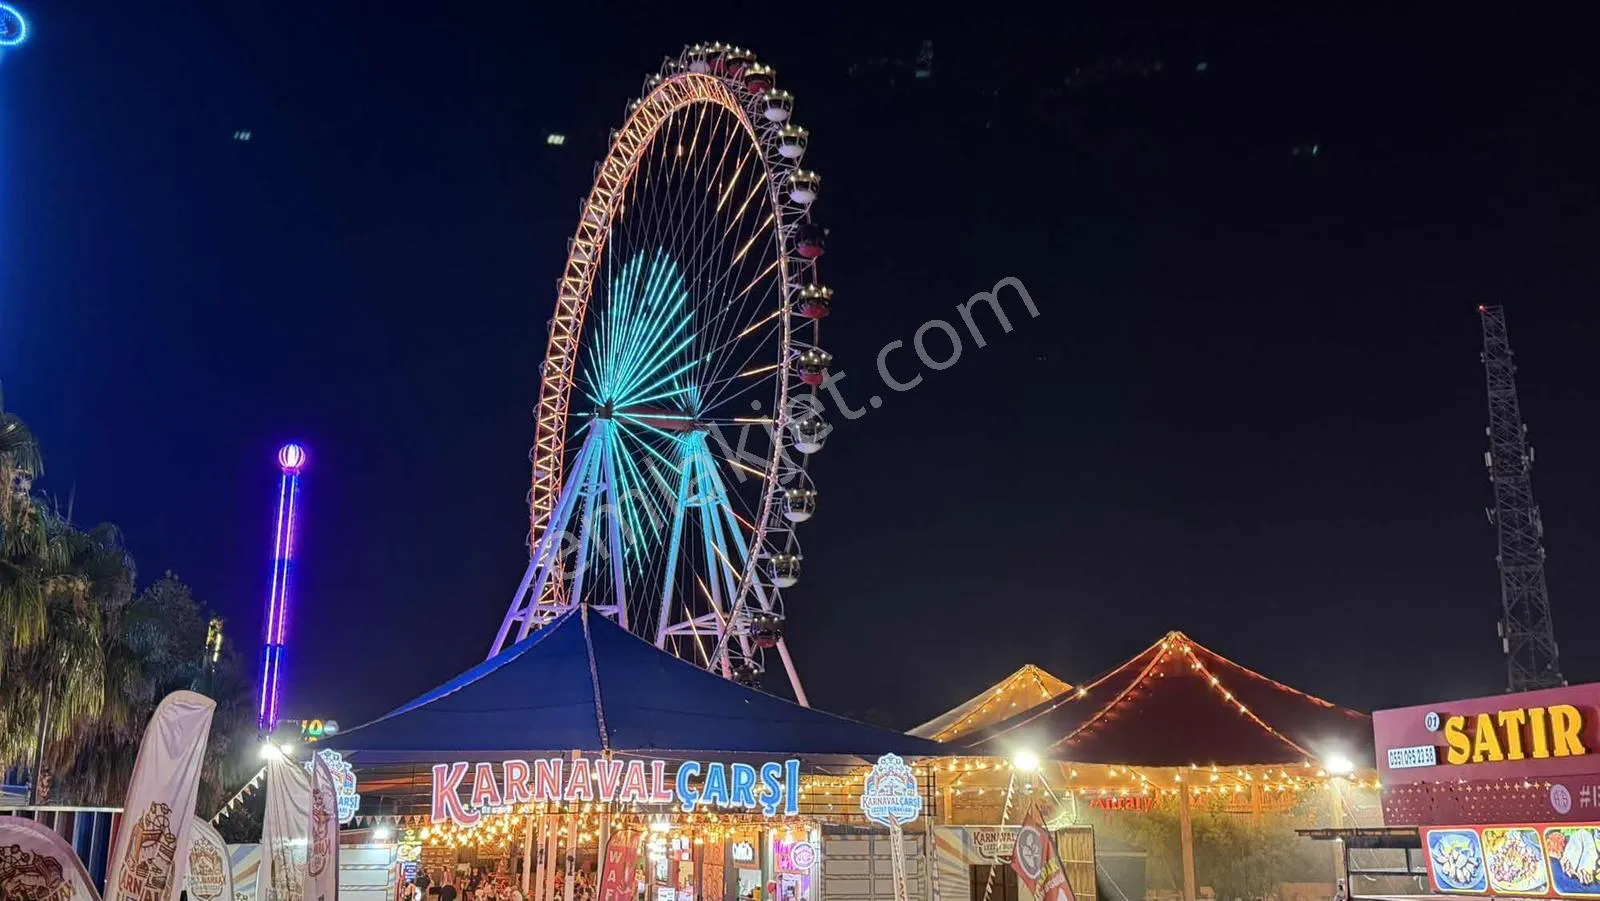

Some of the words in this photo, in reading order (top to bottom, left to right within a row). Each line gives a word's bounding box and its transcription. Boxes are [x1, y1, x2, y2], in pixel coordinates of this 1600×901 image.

[1444, 704, 1586, 765] SATIR
[431, 758, 673, 827] KARNAVAL
[676, 758, 801, 817] ÇARŞI
[862, 796, 899, 808] KARNAVAL
